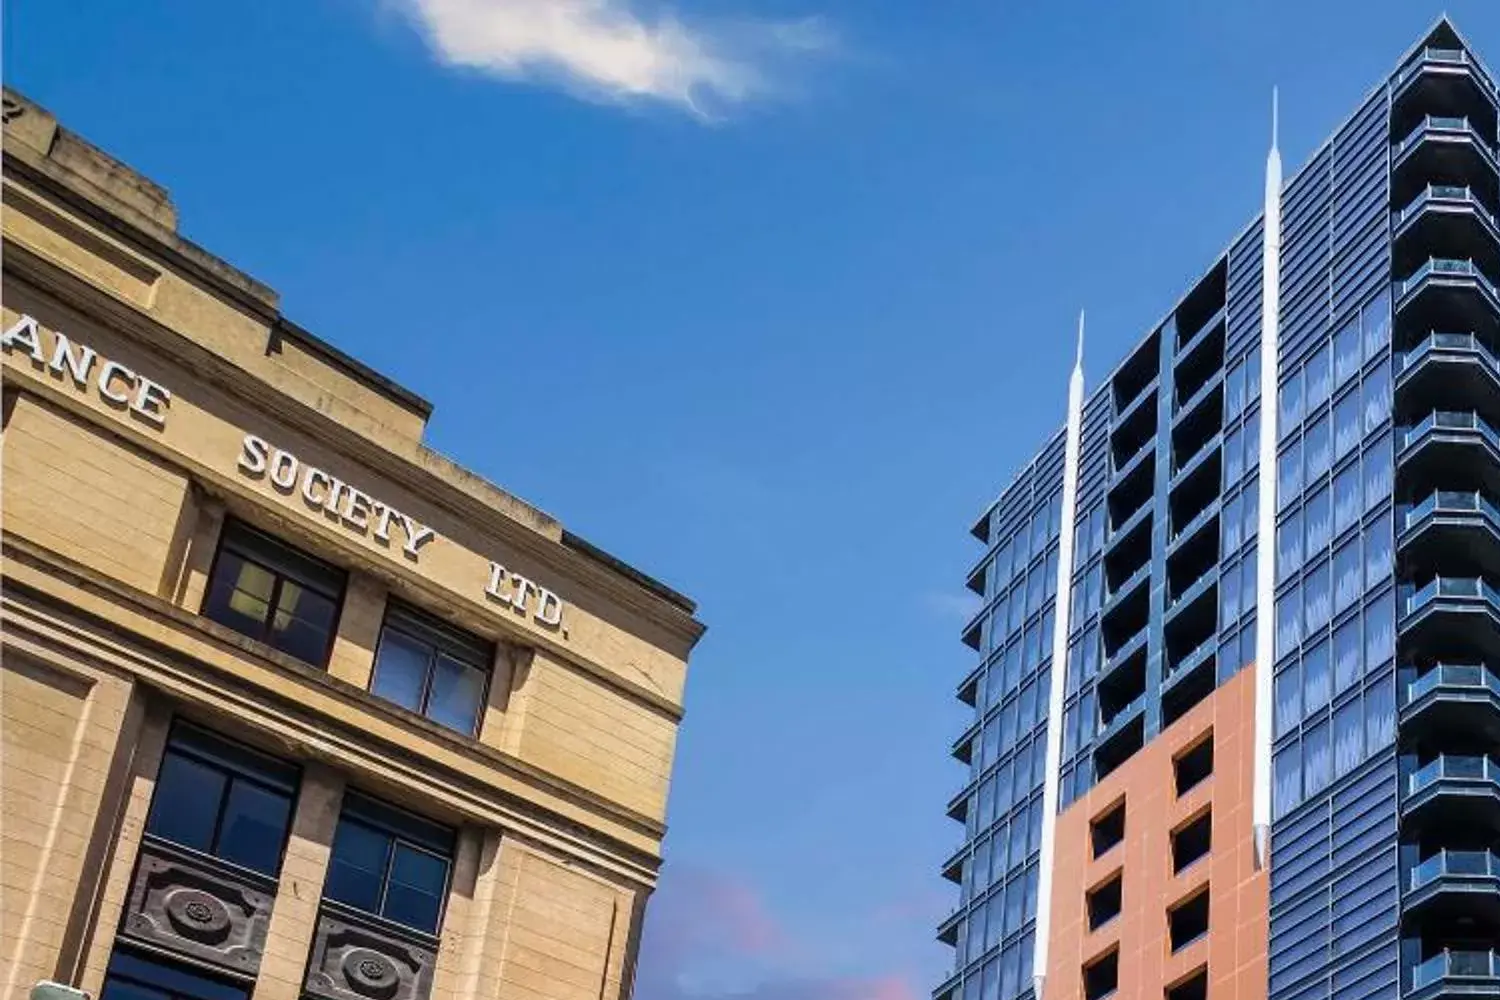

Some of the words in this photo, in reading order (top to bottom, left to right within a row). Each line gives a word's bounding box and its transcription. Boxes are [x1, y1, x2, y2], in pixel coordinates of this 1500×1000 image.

[1, 314, 171, 424] ANCE
[237, 434, 435, 556] SOCIETY
[484, 561, 568, 634] LTD.
